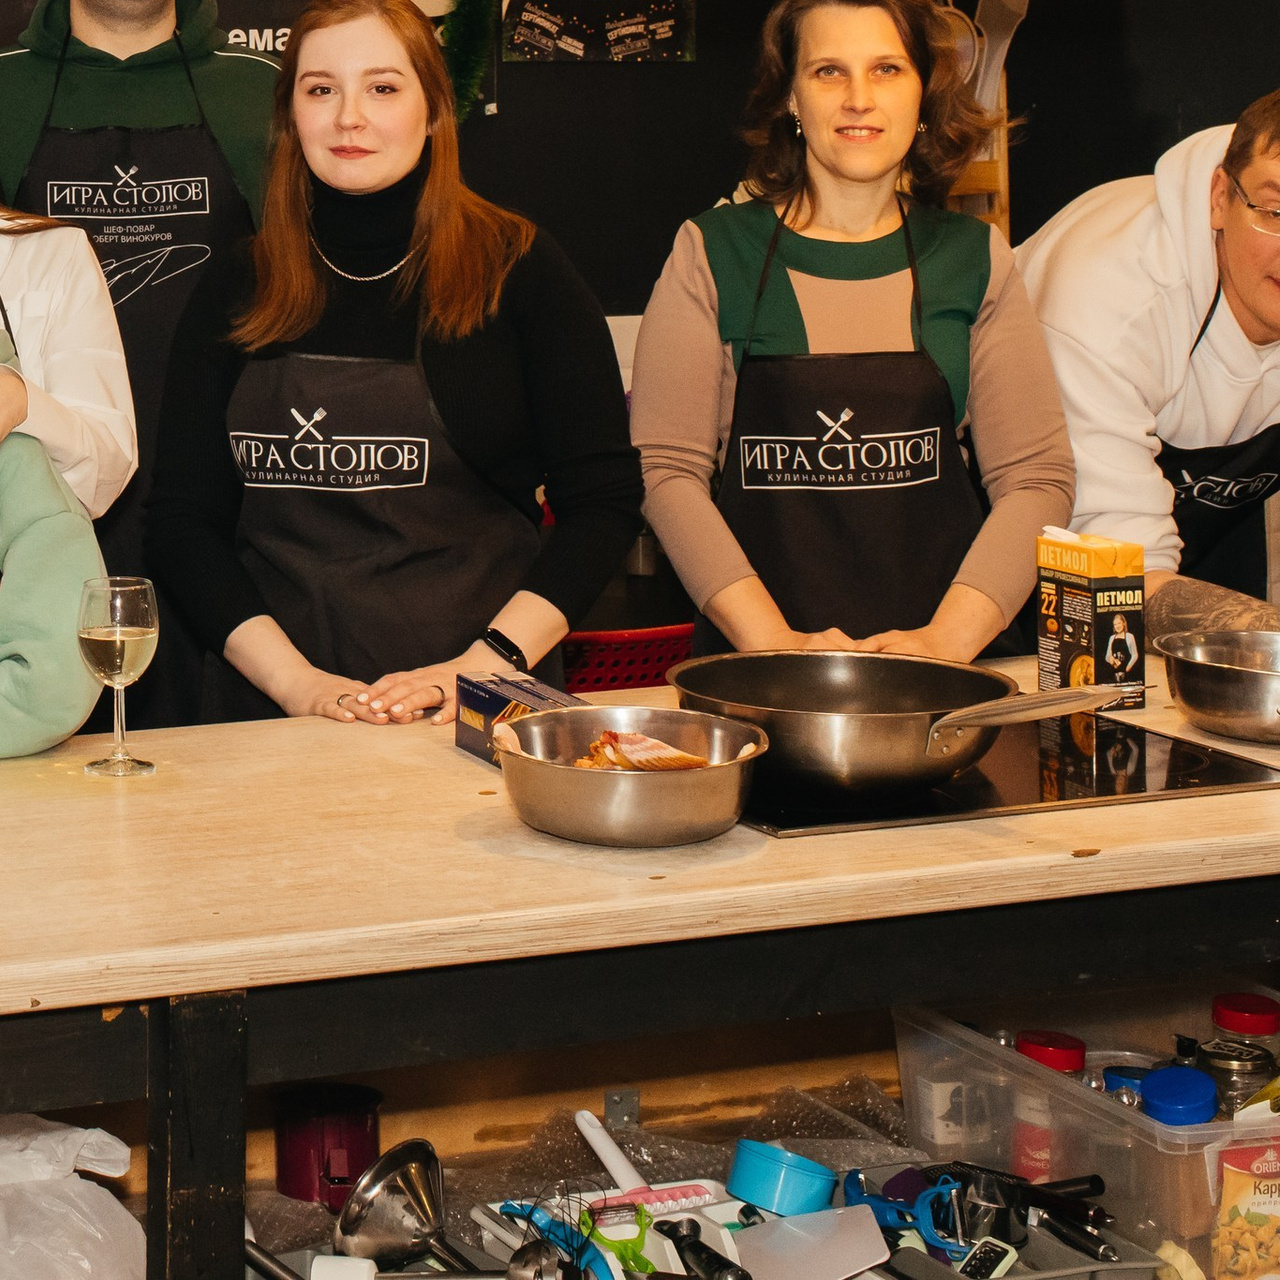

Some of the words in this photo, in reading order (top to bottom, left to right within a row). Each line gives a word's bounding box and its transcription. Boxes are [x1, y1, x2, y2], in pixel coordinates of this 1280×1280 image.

[53, 186, 108, 206] ИГРА
[113, 182, 203, 205] СТОЛОВ
[74, 206, 137, 214] КУЛИНАРНАЯ
[141, 204, 178, 213] СТУДИЯ
[103, 224, 156, 234] ШЕФ-ПОВАР
[93, 234, 119, 244] ОБЕРТ
[121, 232, 173, 243] ВИНОКУРОВ
[232, 438, 286, 469] ИГРА
[290, 443, 419, 471] СТОЛОВ
[744, 443, 812, 471] ИГРА
[818, 435, 934, 470] СТОЛОВ
[245, 470, 323, 484] КУЛИНАРНАЯ
[329, 473, 381, 485] СТУДИЯ
[767, 473, 854, 483] КУЛИНАРНАЯ
[861, 469, 912, 482] СТУДИЯ
[1040, 543, 1088, 573] ПЕТМОЛ
[1096, 590, 1142, 607] ПЕТМОЛ
